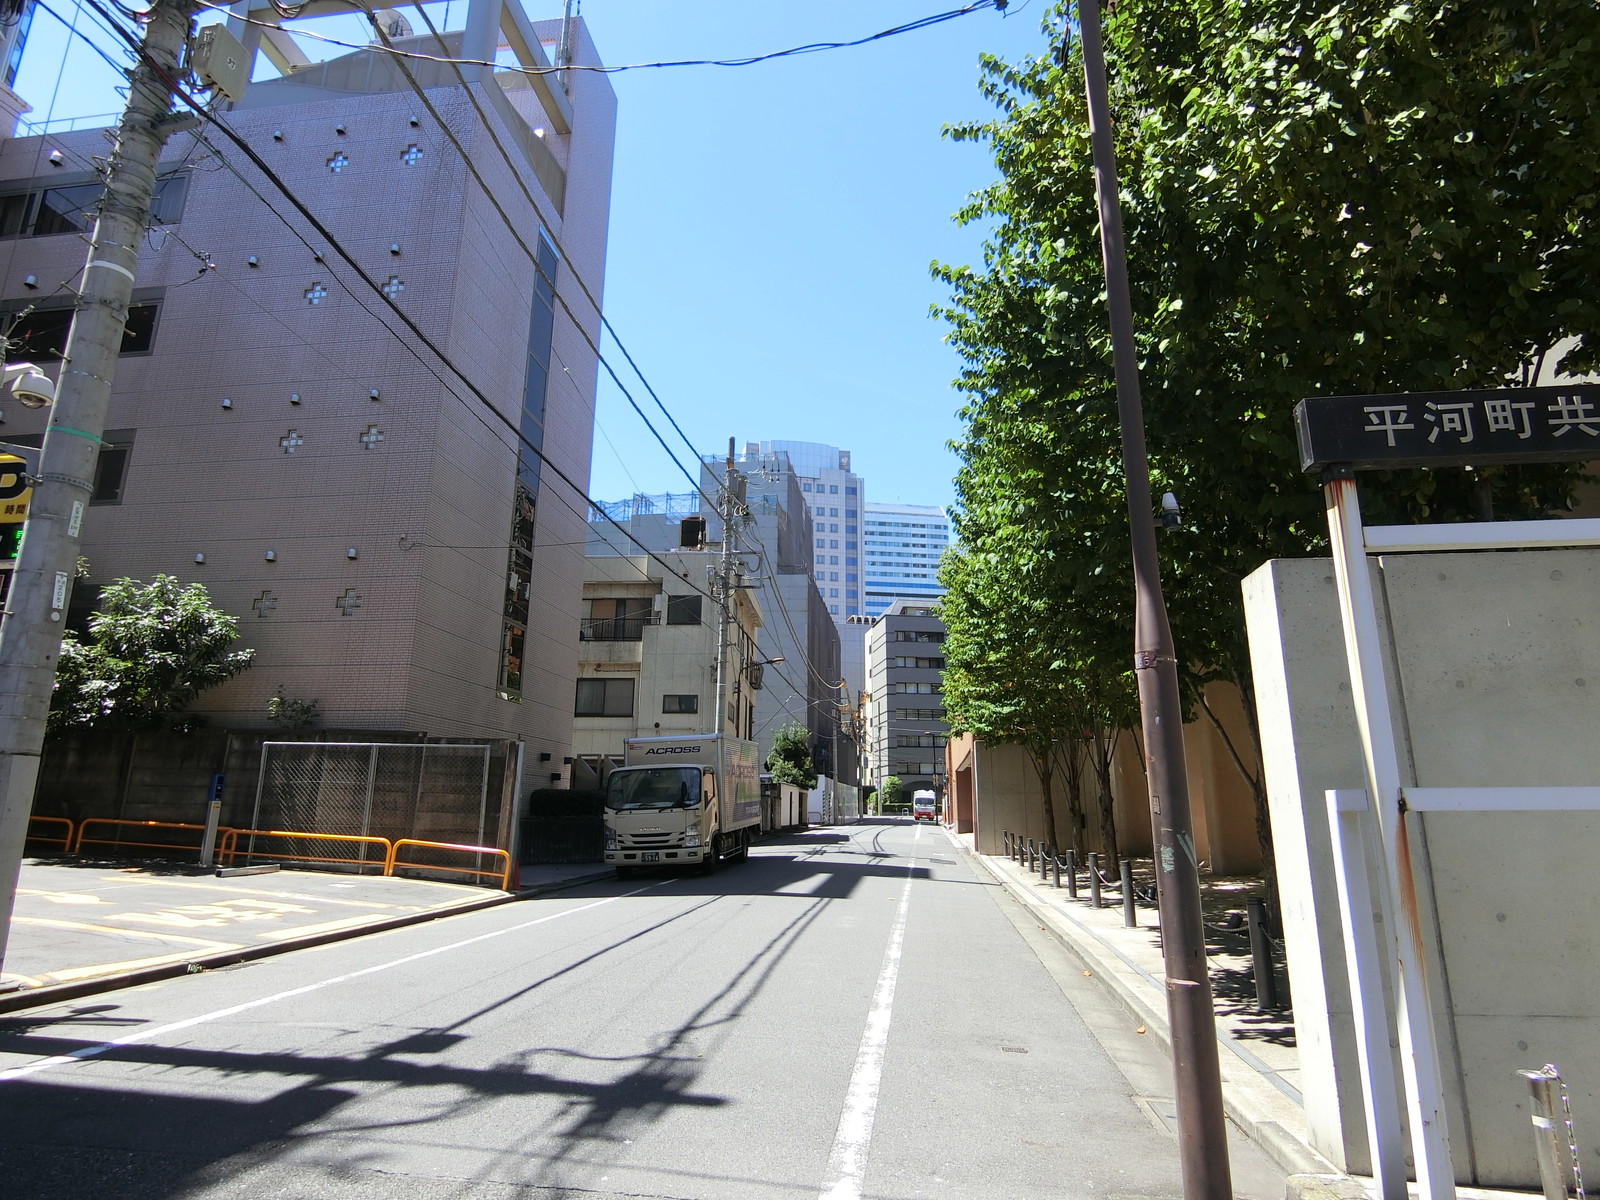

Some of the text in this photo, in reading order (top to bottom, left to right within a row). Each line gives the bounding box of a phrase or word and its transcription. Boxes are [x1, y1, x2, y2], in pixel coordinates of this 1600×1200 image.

[1363, 395, 1600, 447] 平河町共
[645, 745, 701, 756] ACROSS
